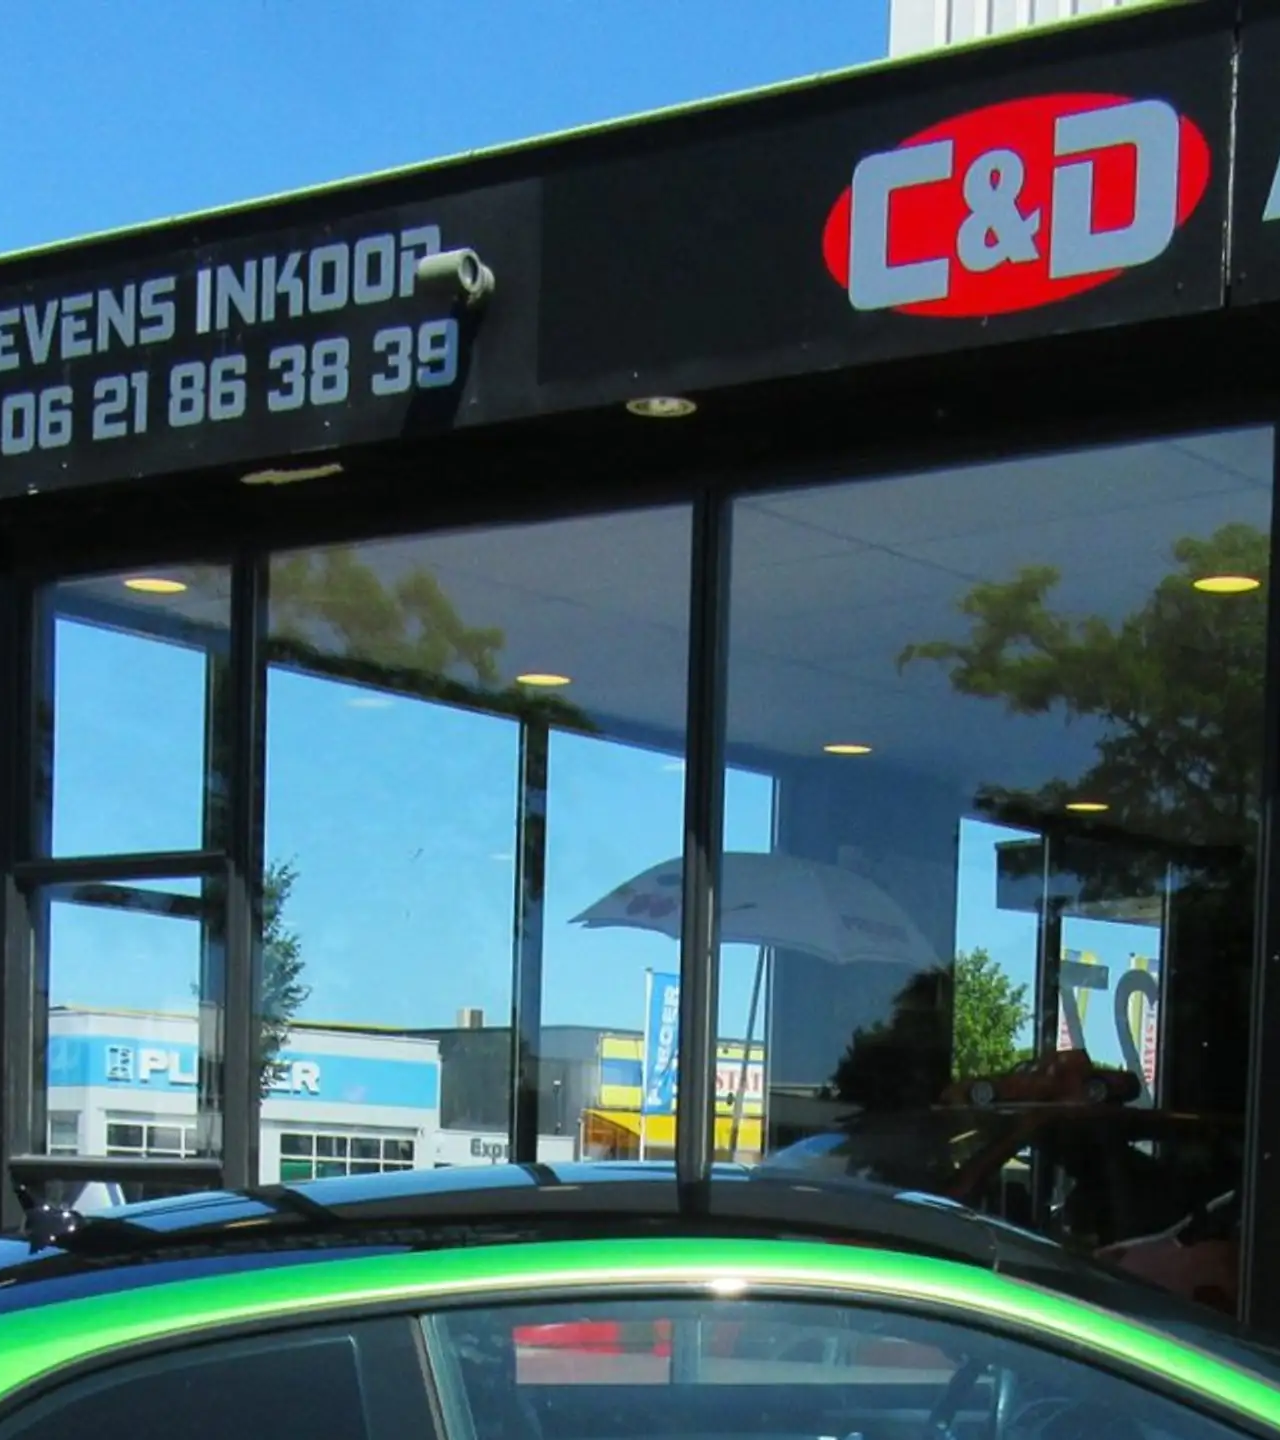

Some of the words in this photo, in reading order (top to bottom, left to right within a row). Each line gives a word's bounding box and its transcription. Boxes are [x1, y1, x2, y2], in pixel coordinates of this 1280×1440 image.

[847, 98, 1181, 312] C&D
[196, 223, 442, 335] INKOOP
[0, 385, 73, 457] 06
[92, 370, 148, 442] 21
[168, 353, 248, 428] 86
[267, 336, 351, 413] 38
[371, 317, 460, 397] 39
[139, 1048, 322, 1096] PLER
[470, 1138, 511, 1165] Exp
